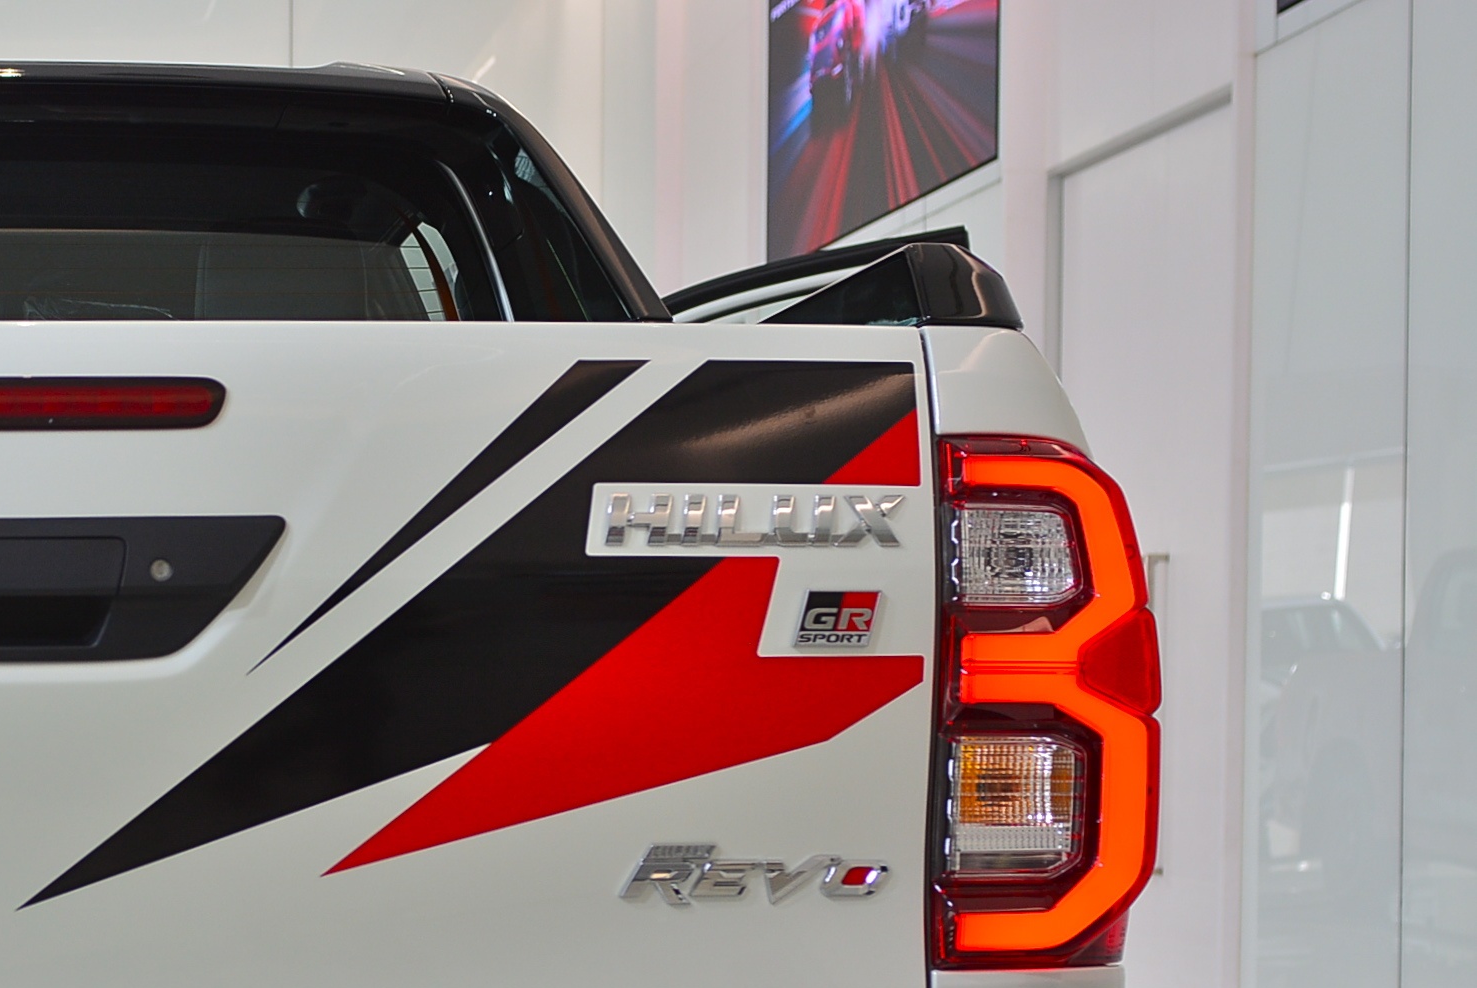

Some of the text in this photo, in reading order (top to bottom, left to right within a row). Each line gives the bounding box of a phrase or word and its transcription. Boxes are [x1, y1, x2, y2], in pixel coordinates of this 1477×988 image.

[604, 493, 907, 548] HILUX
[797, 632, 869, 644] SPORT
[803, 607, 873, 631] GR
[619, 853, 890, 905] REVO
